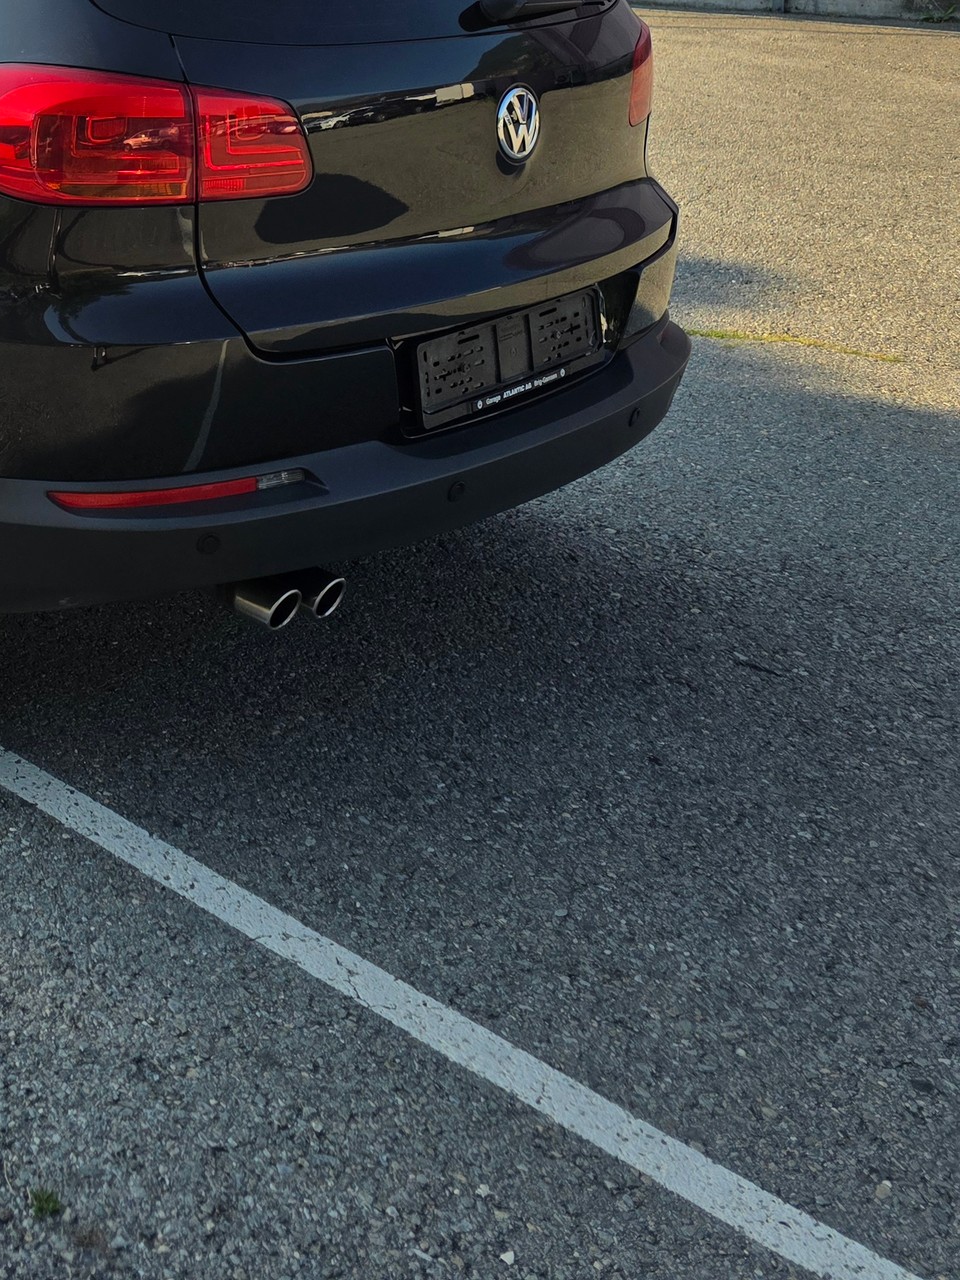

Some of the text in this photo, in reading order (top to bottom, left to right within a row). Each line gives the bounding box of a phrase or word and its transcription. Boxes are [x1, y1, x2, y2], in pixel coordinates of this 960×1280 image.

[498, 87, 539, 158] VW
[486, 395, 501, 405] Garage
[503, 384, 525, 398] ATLANTIC
